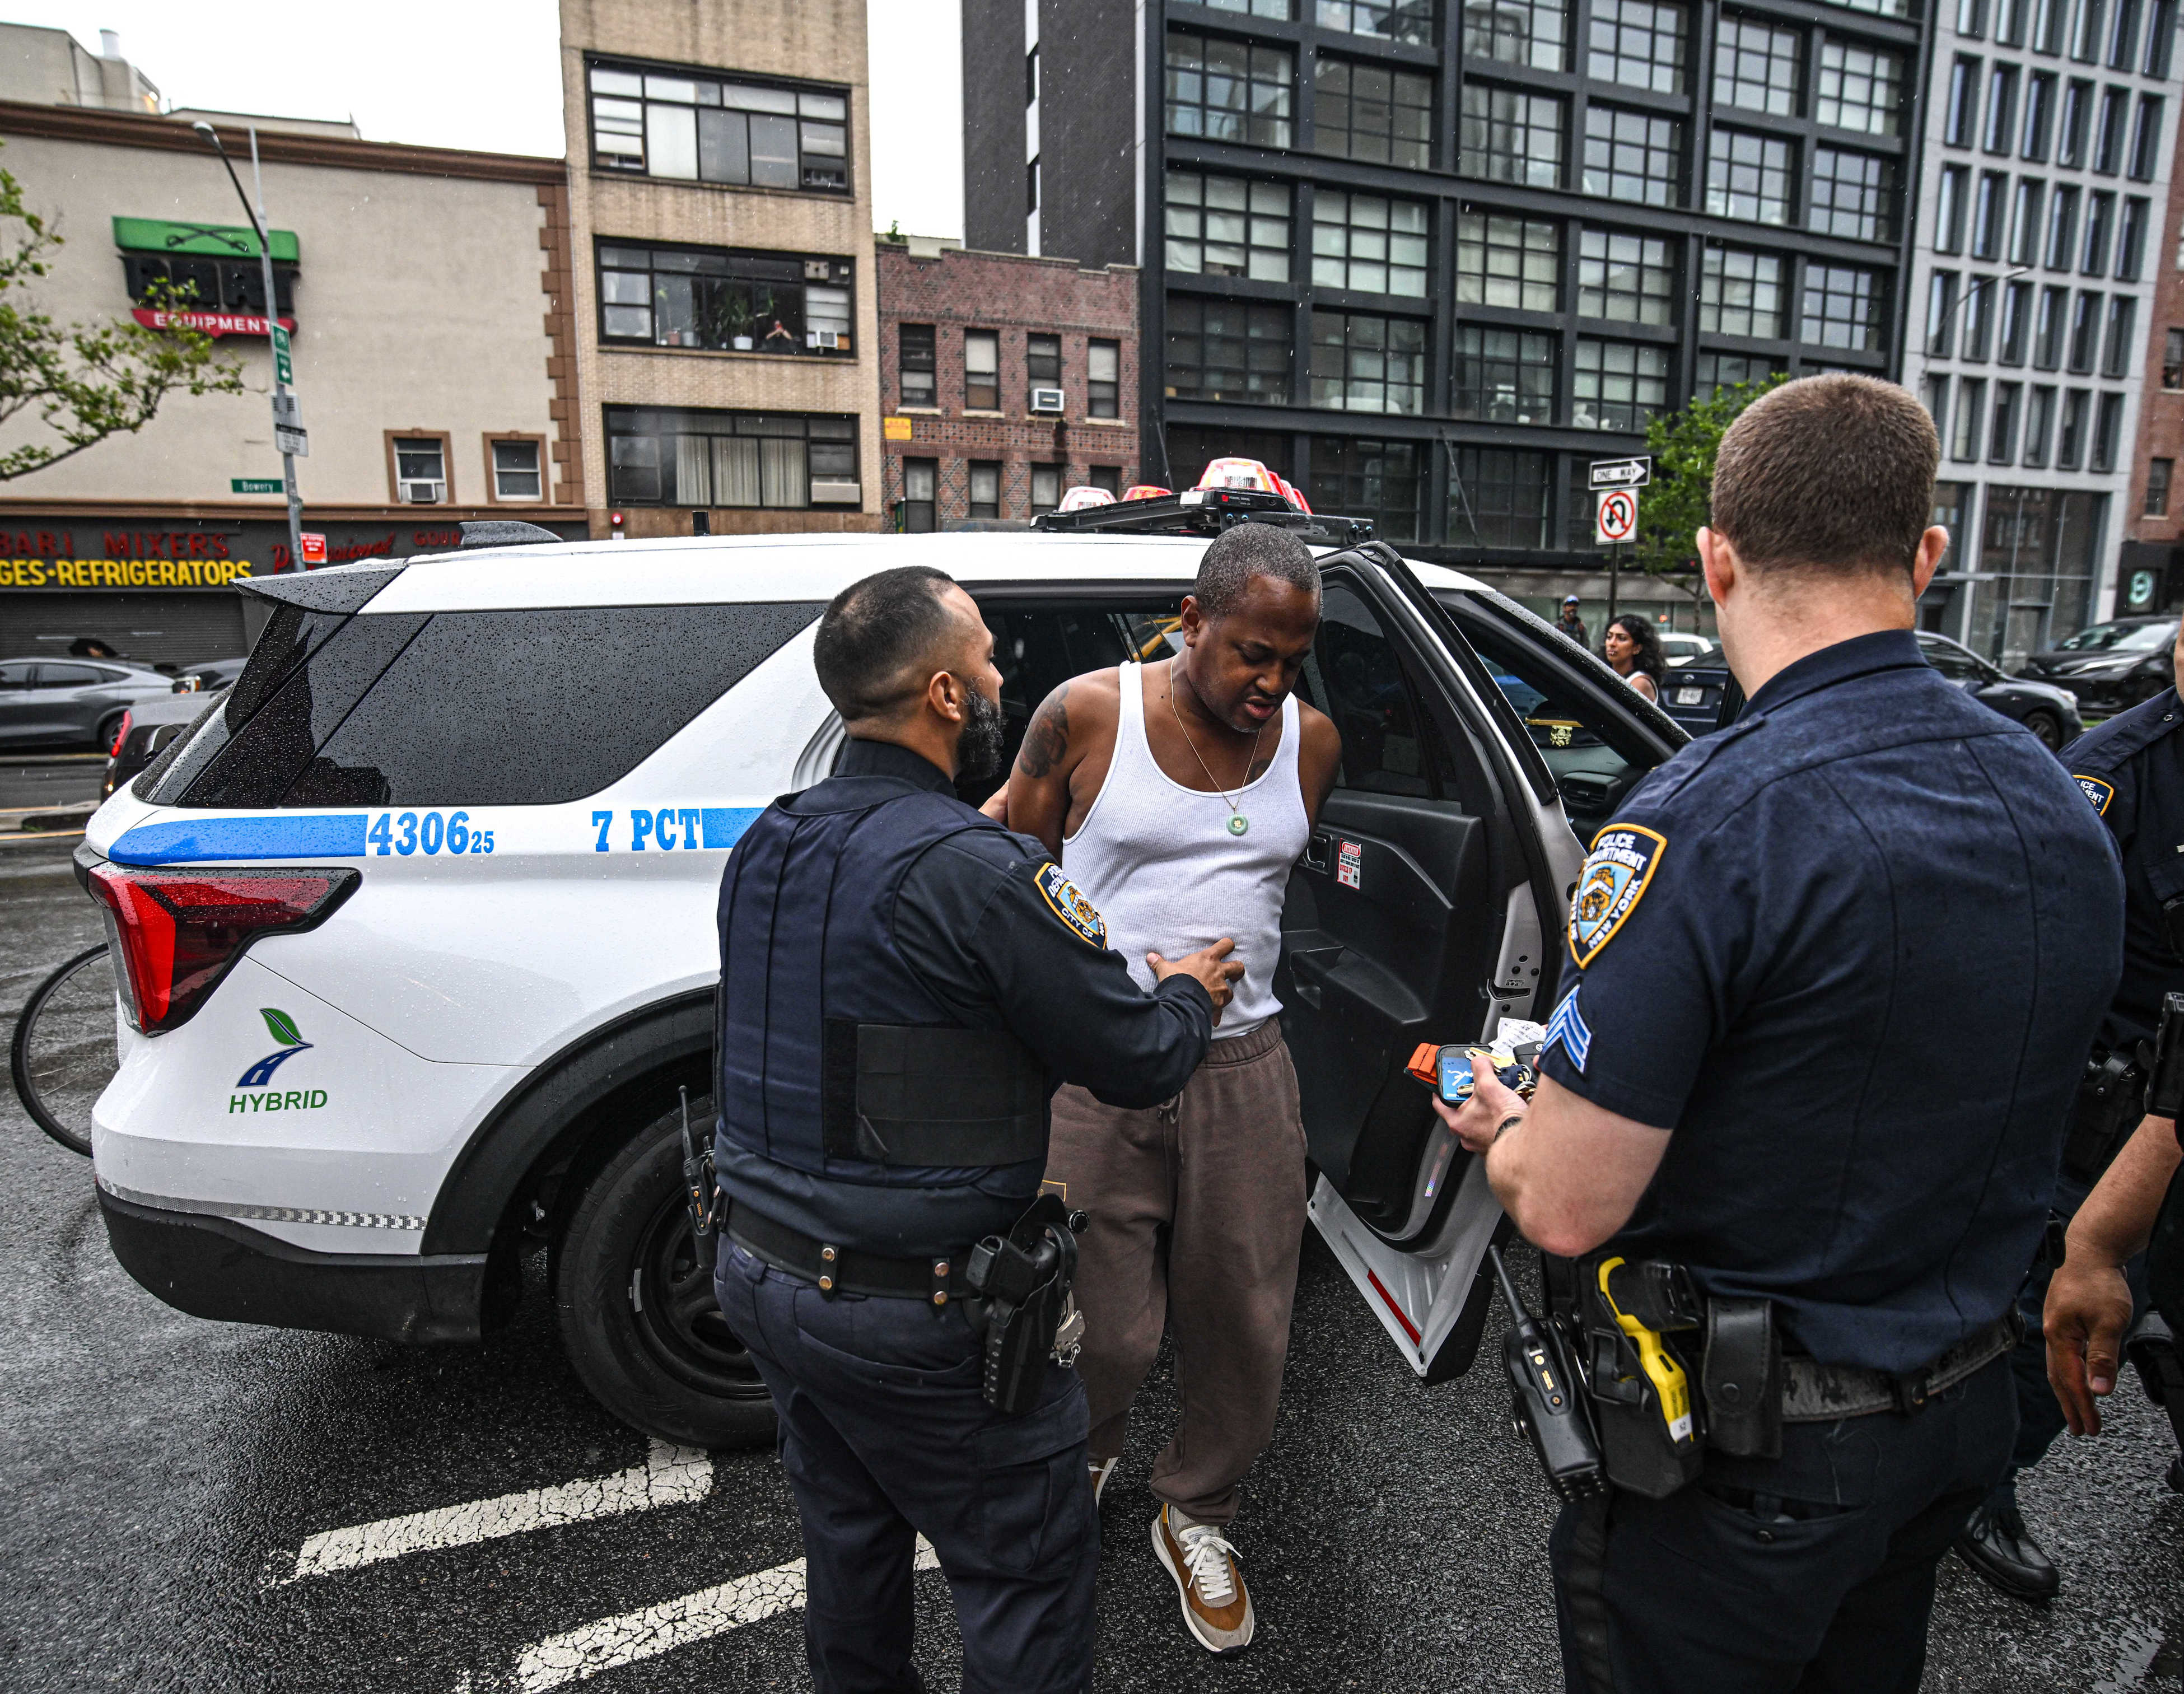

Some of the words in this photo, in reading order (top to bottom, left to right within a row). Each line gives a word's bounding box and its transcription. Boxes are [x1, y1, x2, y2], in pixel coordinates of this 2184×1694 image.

[242, 480, 274, 493] Bowery
[1597, 470, 1612, 480] ONE
[1621, 468, 1637, 479] WAY
[103, 532, 229, 559] MIXERS
[367, 811, 470, 856] 4306
[471, 830, 494, 854] 25
[592, 810, 614, 852] 7
[631, 808, 701, 851] PCT
[1595, 833, 1636, 850] POLICE
[1061, 907, 1081, 928] CITY
[1082, 927, 1094, 938] OF
[1588, 920, 1612, 949] NEW
[1611, 879, 1642, 919] YORK
[229, 1090, 328, 1114] HYBRID
